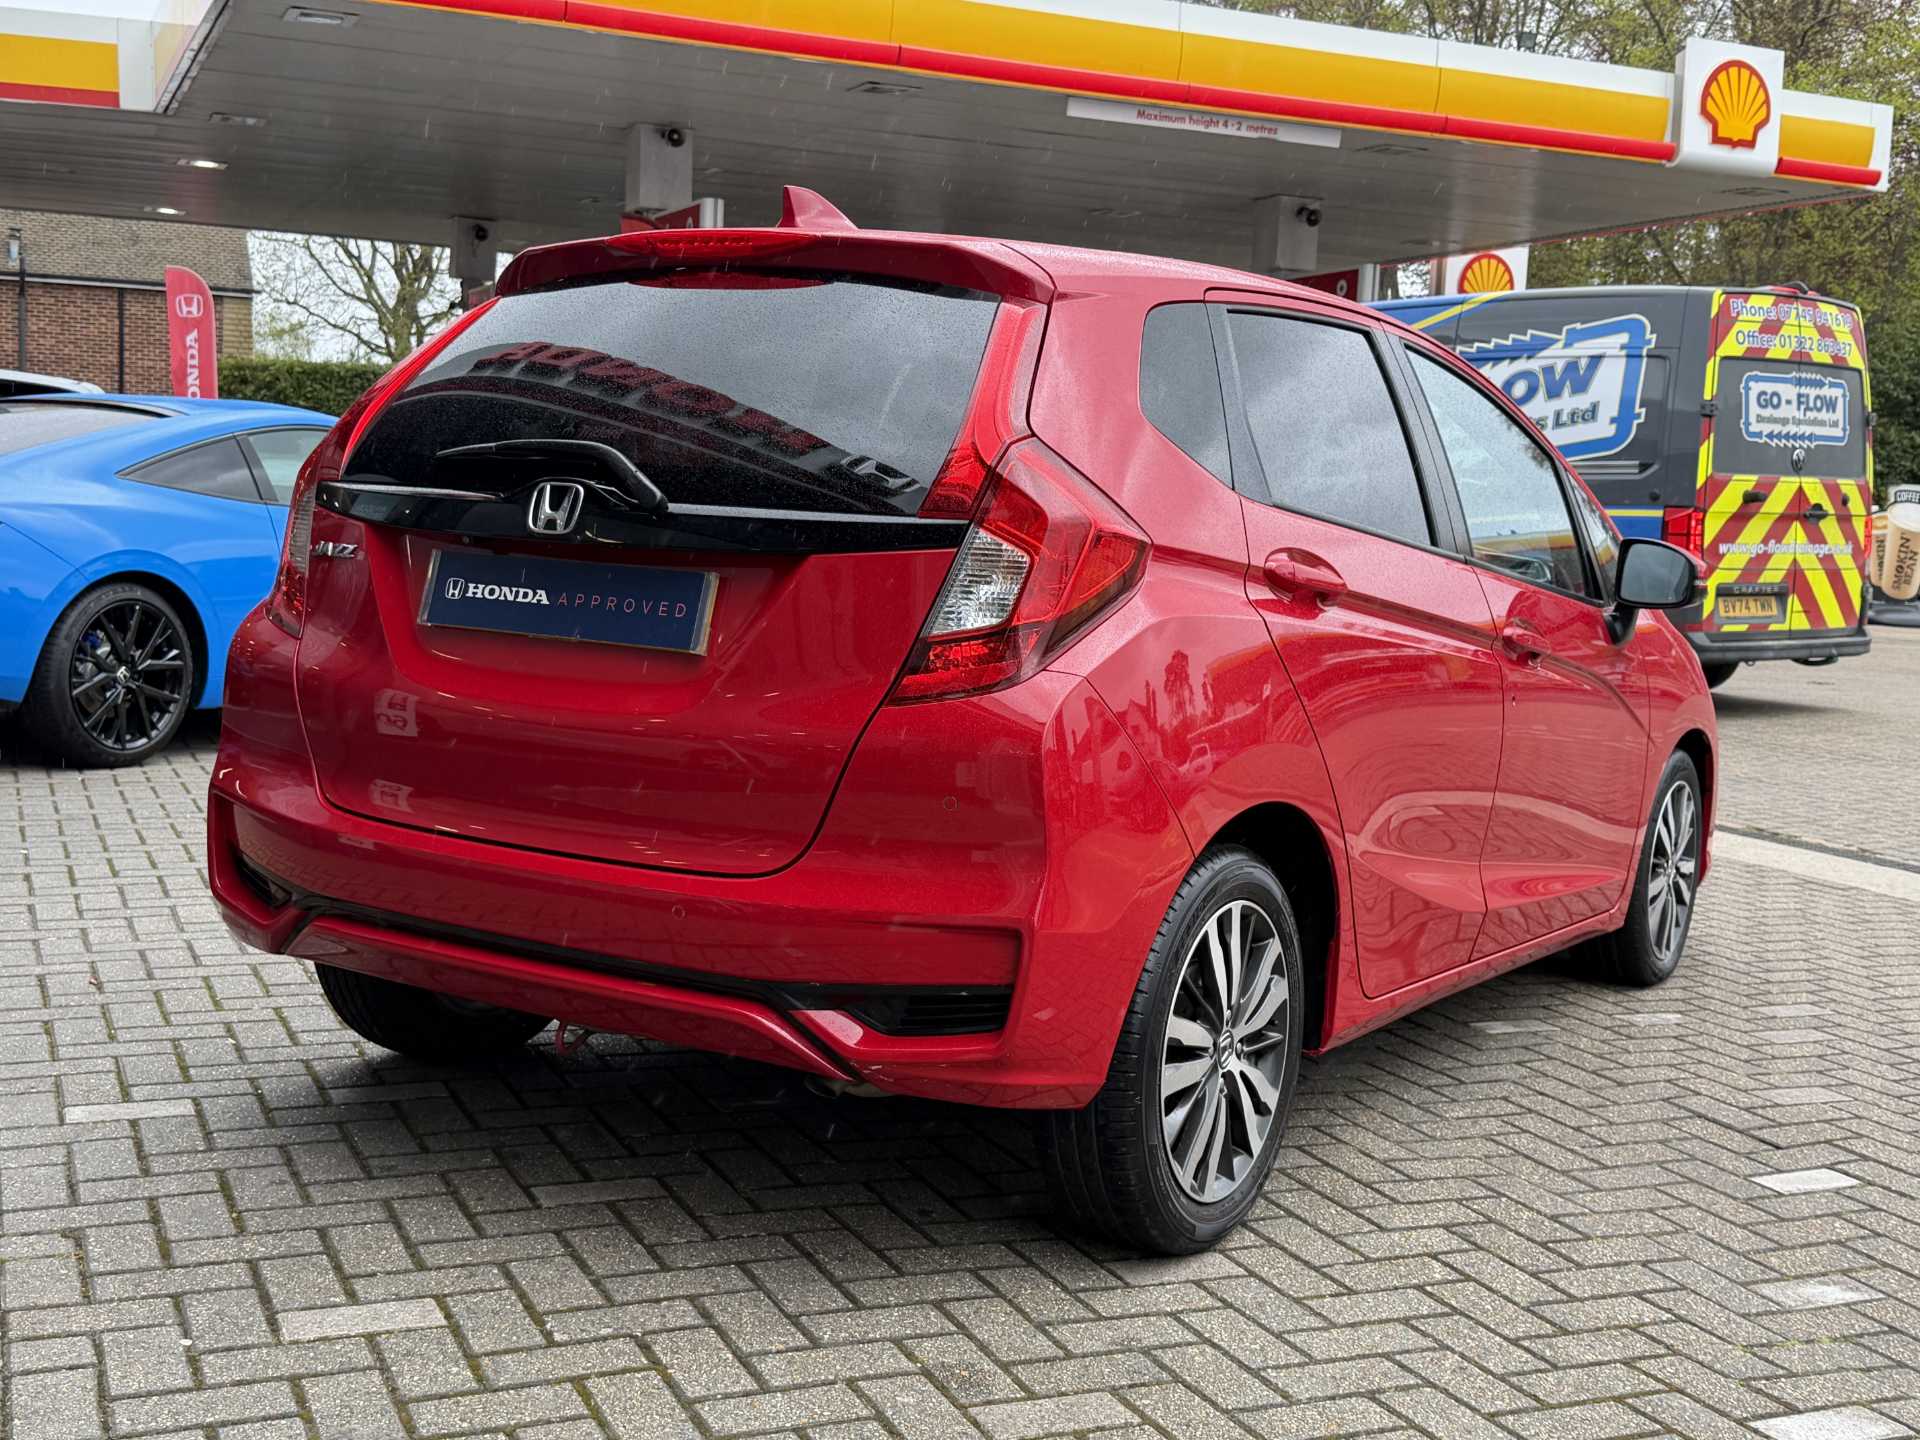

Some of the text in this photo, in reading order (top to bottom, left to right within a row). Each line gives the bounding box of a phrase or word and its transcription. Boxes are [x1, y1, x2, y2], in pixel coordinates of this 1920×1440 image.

[1136, 108, 1186, 124] Maximum
[1188, 115, 1220, 129] height
[1246, 123, 1279, 135] metres
[1729, 298, 1776, 319] Phone:
[1735, 329, 1777, 347] Office:
[1779, 334, 1815, 352] 01322
[185, 327, 200, 398] ONDA
[1501, 353, 1606, 407] OW
[1552, 401, 1600, 431] Ltd
[1756, 390, 1782, 410] GO
[1796, 393, 1839, 415] FLOW
[1896, 491, 1920, 503] COFFEE
[310, 540, 359, 558] JAZZ
[1902, 548, 1920, 586] BEAN
[466, 583, 550, 605] HONDA
[557, 592, 688, 619] APPROVED
